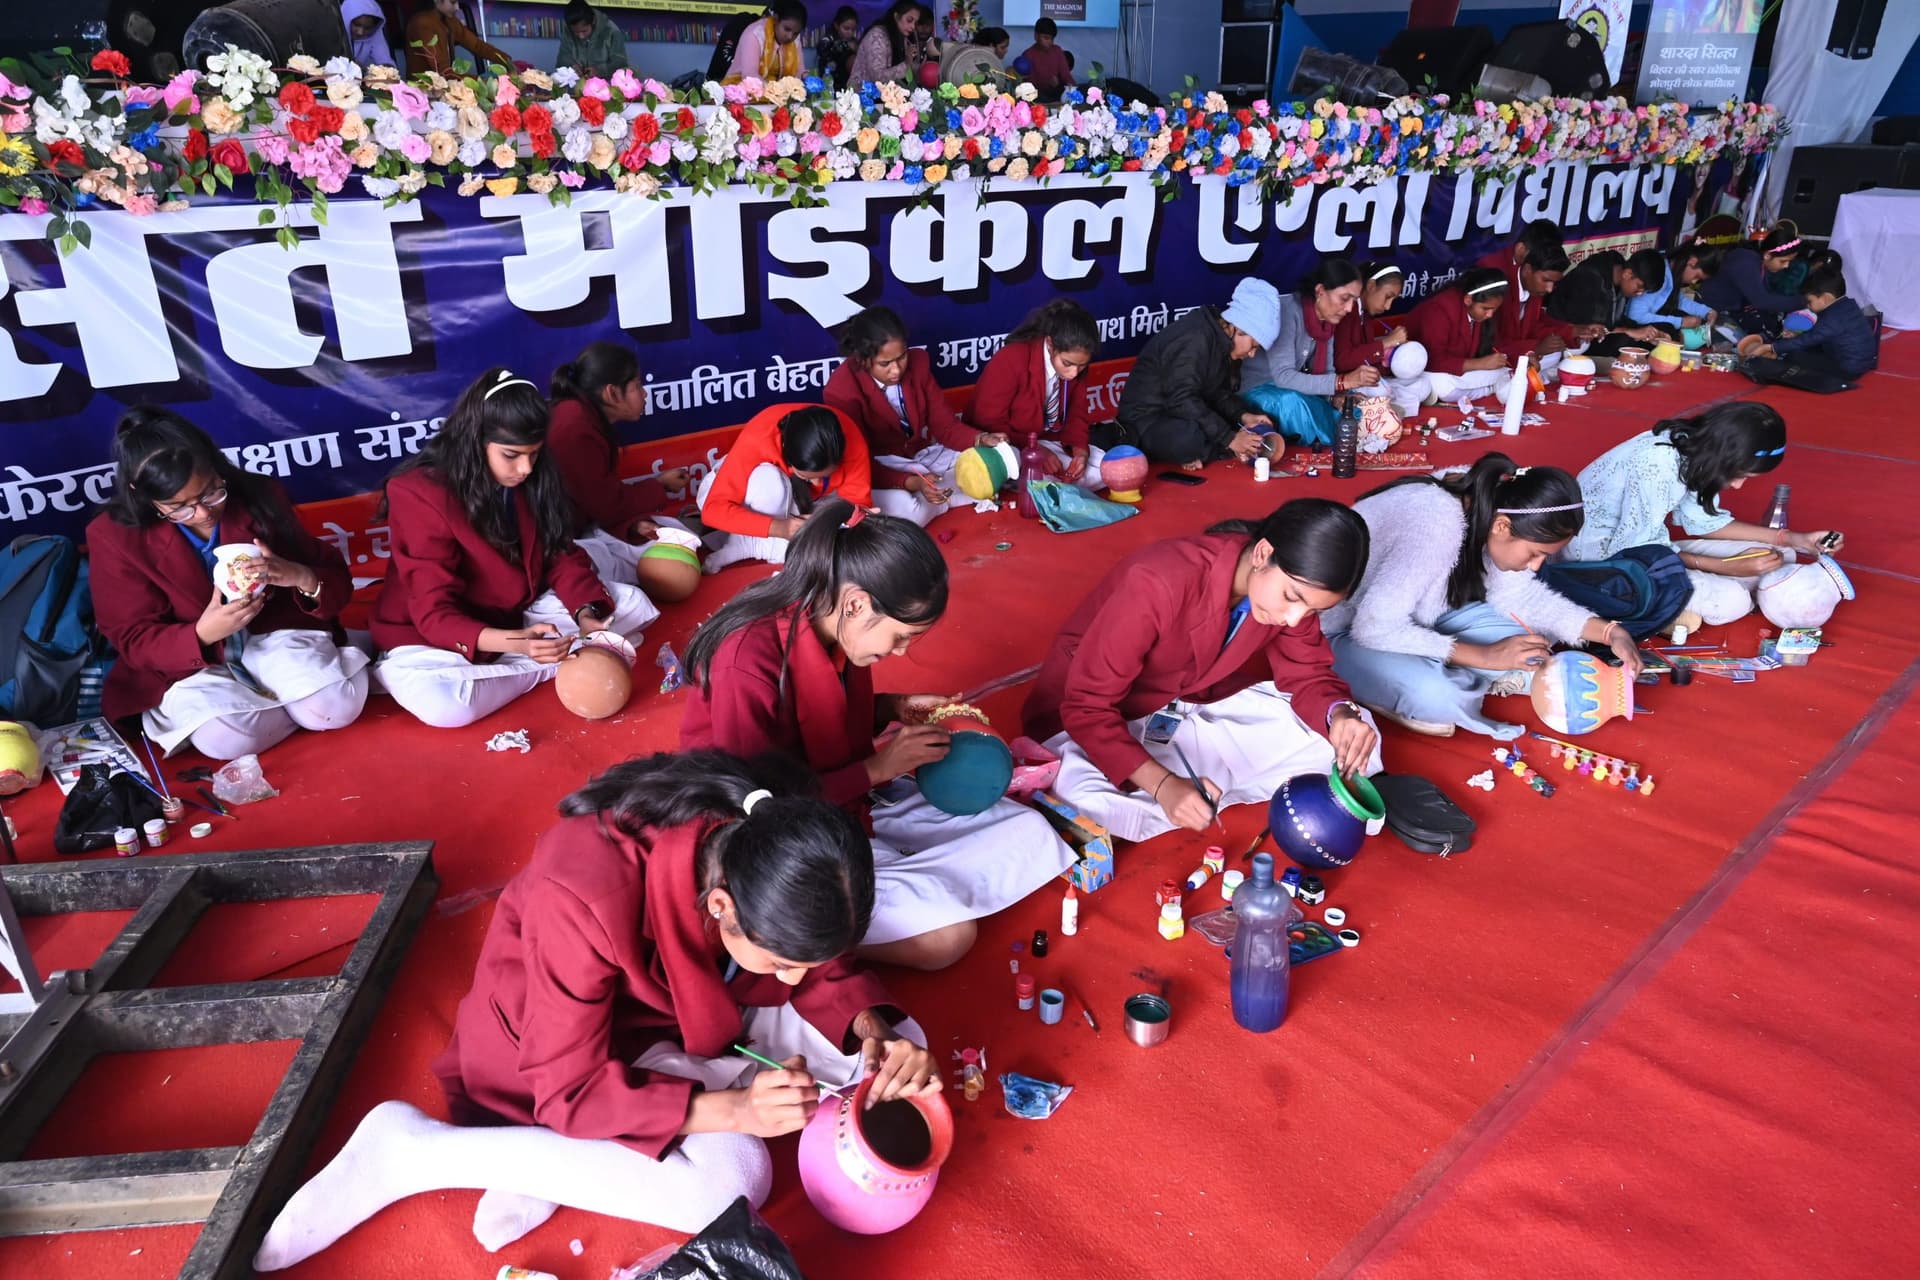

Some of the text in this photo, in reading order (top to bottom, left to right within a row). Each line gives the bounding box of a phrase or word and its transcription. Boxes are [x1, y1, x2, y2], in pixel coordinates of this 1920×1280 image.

[1056, 3, 1083, 11] MAGNUM
[1660, 43, 1738, 60] शारदा सिन्हा
[1649, 78, 1681, 90] भोजपुरी
[480, 172, 1157, 329] माइकल
[765, 355, 846, 393] बेहत
